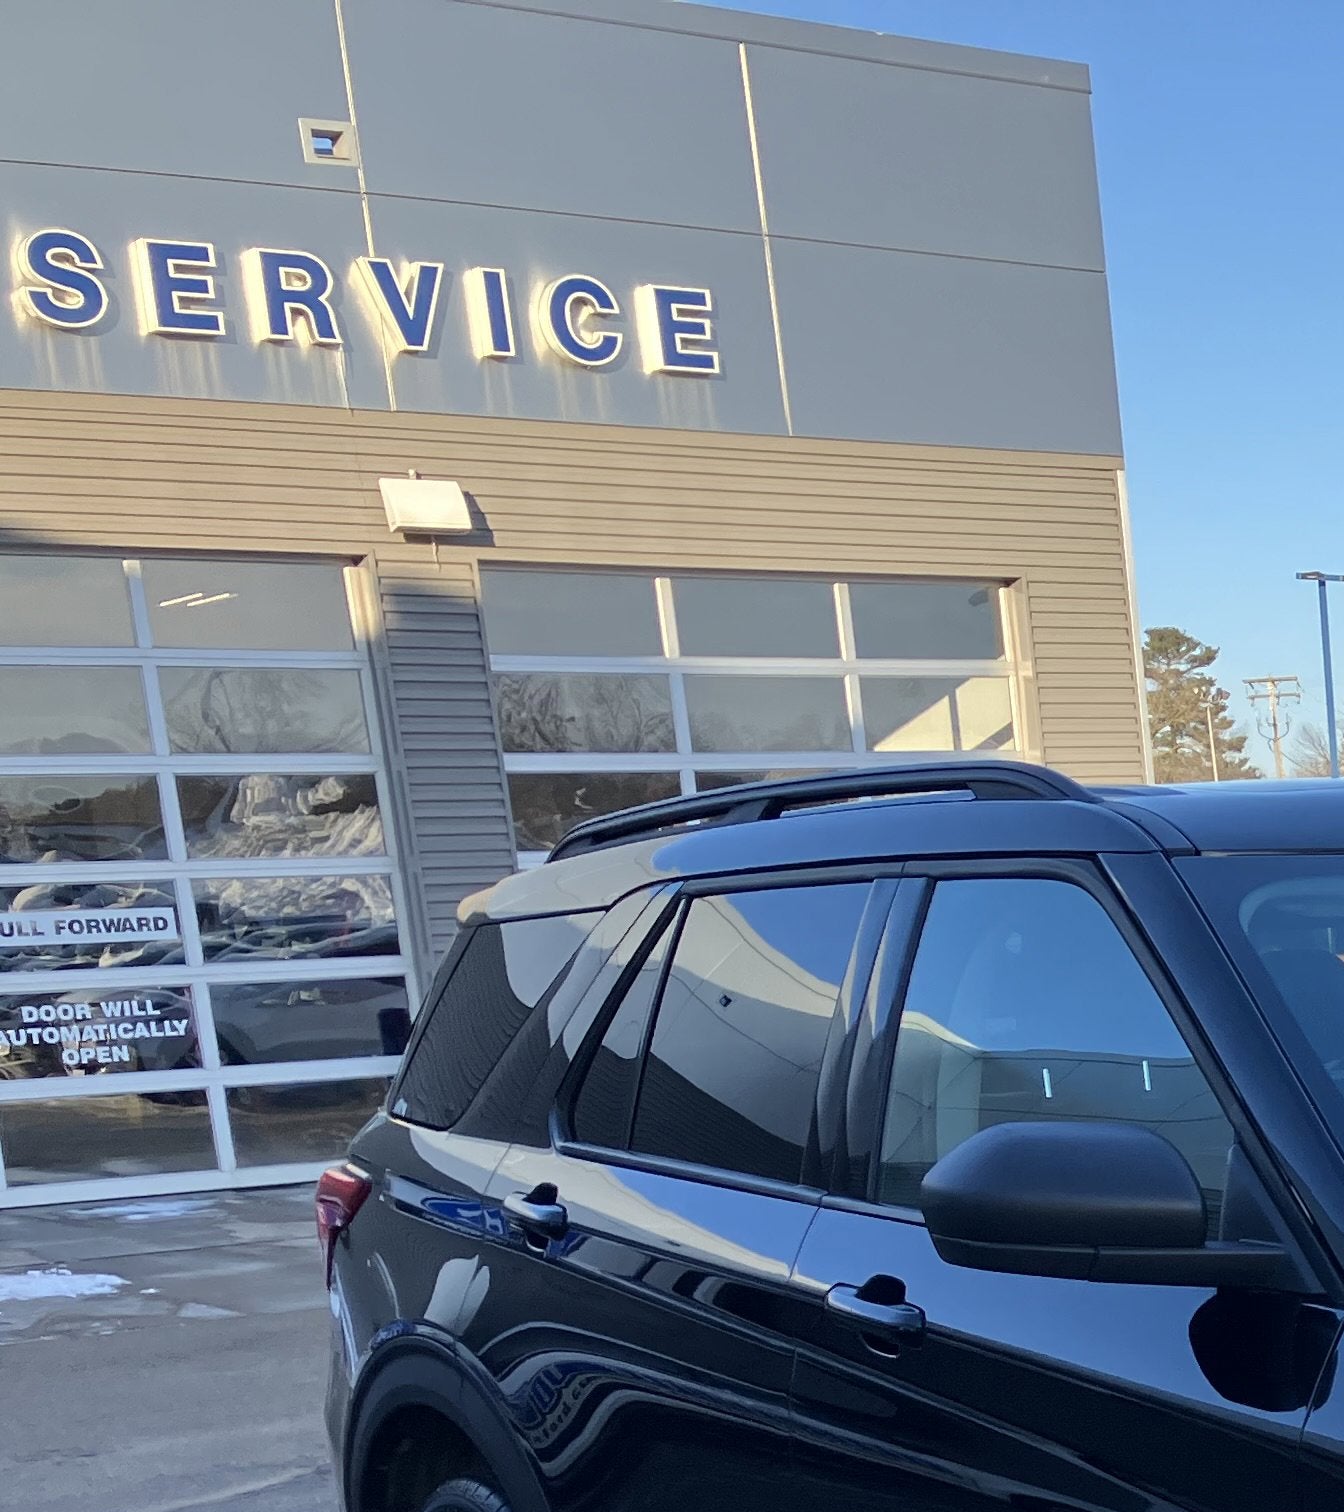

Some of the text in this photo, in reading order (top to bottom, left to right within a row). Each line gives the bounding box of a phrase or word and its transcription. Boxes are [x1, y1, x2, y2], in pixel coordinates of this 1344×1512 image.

[16, 227, 721, 375] SERVICE
[0, 916, 168, 938] ULL FORWARD
[21, 999, 161, 1024] DOOR WILL
[61, 1045, 130, 1066] OPEN
